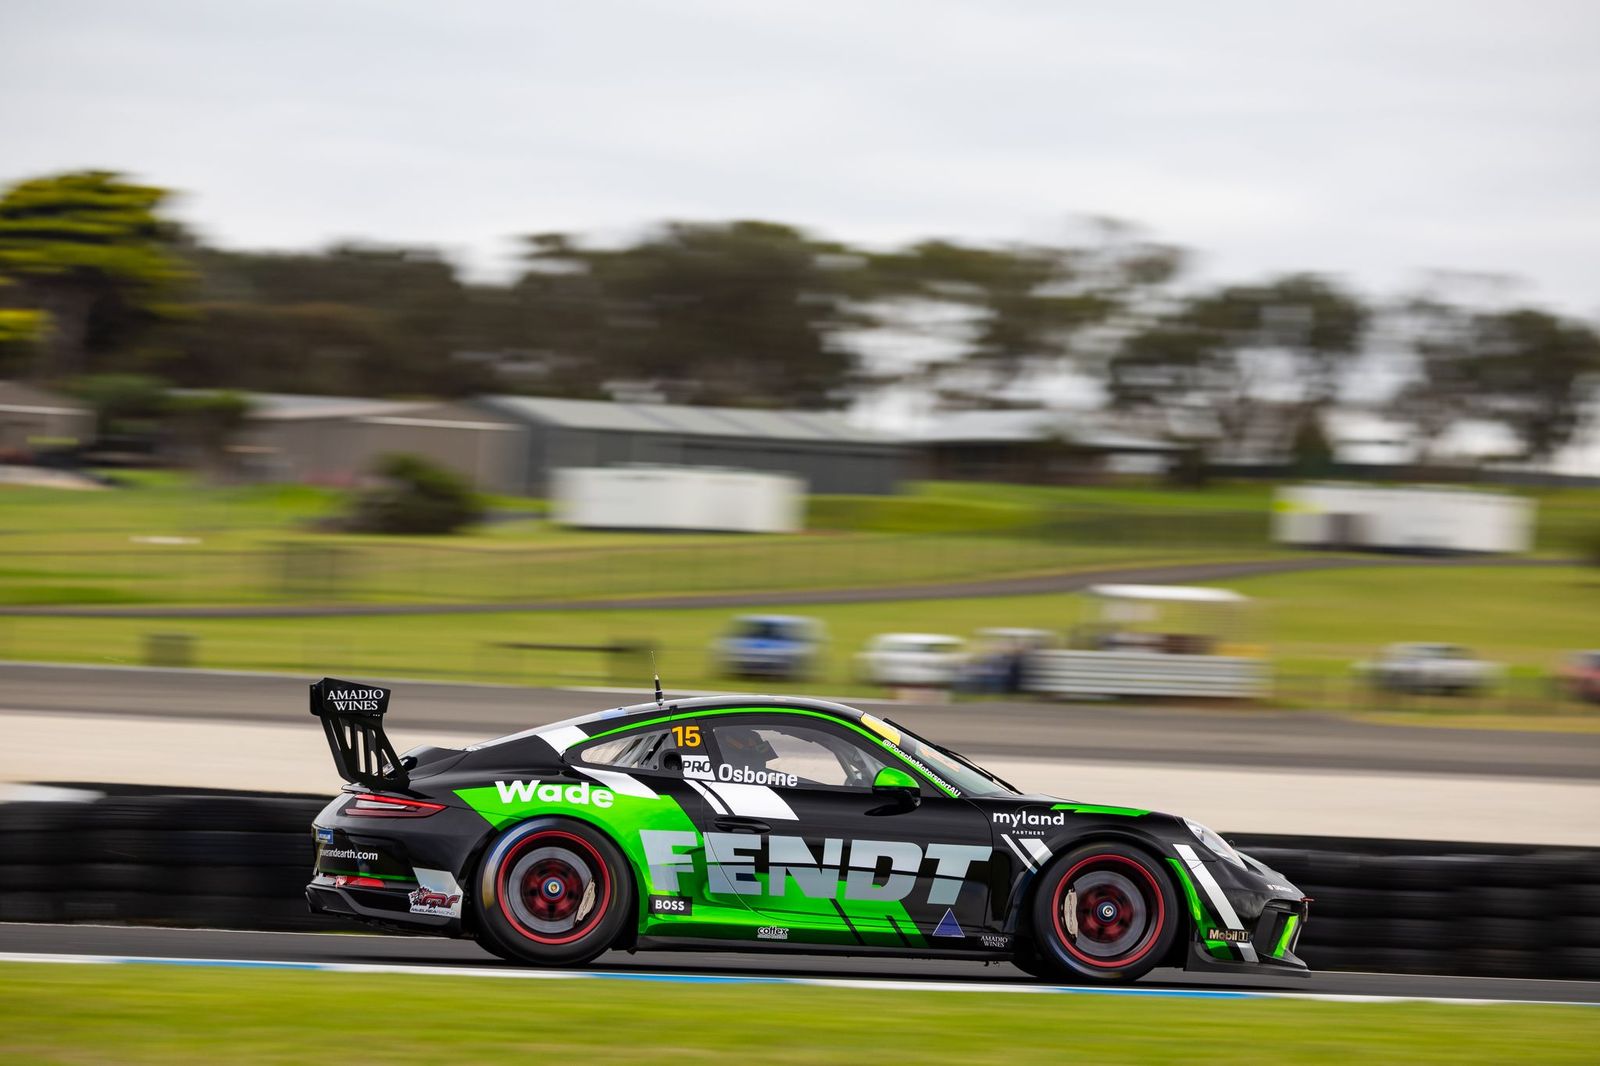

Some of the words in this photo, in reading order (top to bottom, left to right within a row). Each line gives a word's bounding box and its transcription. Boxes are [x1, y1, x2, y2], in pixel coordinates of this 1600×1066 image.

[327, 689, 384, 700] AMADIO
[333, 700, 379, 711] WINES
[671, 725, 701, 747] 15
[682, 760, 712, 773] PRO
[718, 763, 798, 787] Osborne
[494, 780, 614, 808] Wade
[993, 811, 1065, 828] myland
[639, 829, 993, 905] FENDT
[654, 899, 685, 911] BOSS
[981, 935, 1008, 943] AMADIO
[1209, 929, 1238, 941] Mobil
[984, 940, 1005, 948] WINES
